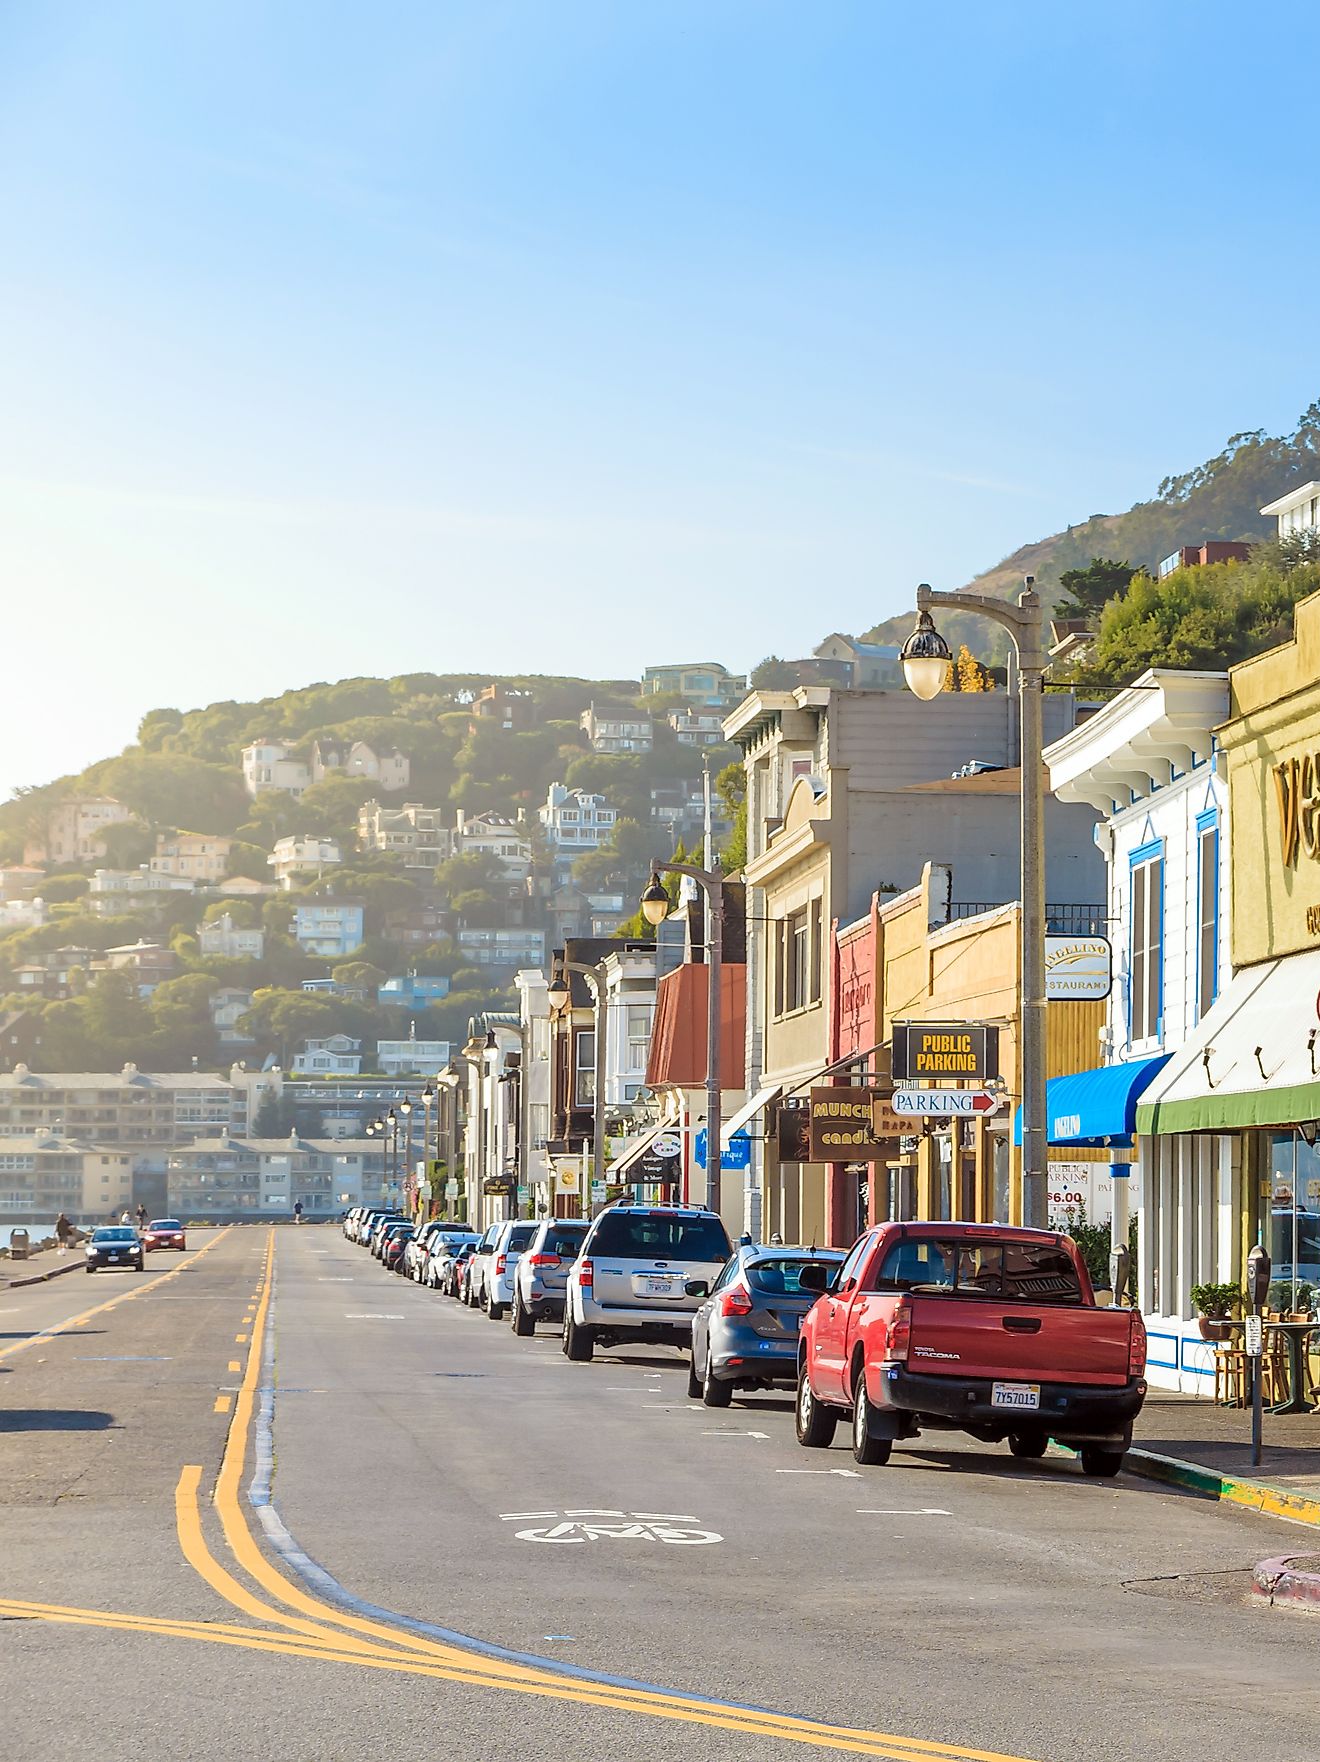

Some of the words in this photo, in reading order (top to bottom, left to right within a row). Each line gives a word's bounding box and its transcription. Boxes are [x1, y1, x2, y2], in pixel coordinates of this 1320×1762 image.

[1046, 981, 1106, 990] STAURANT
[922, 1035, 971, 1053] PUBLIC
[917, 1053, 977, 1071] PARKING
[813, 1102, 872, 1119] MUNCH
[896, 1095, 972, 1111] PARKING
[1049, 1164, 1082, 1173] PUBLIC
[1048, 1173, 1088, 1183] ARKING
[914, 1351, 961, 1360] TACOMA
[995, 1391, 1037, 1406] 7Y57015
